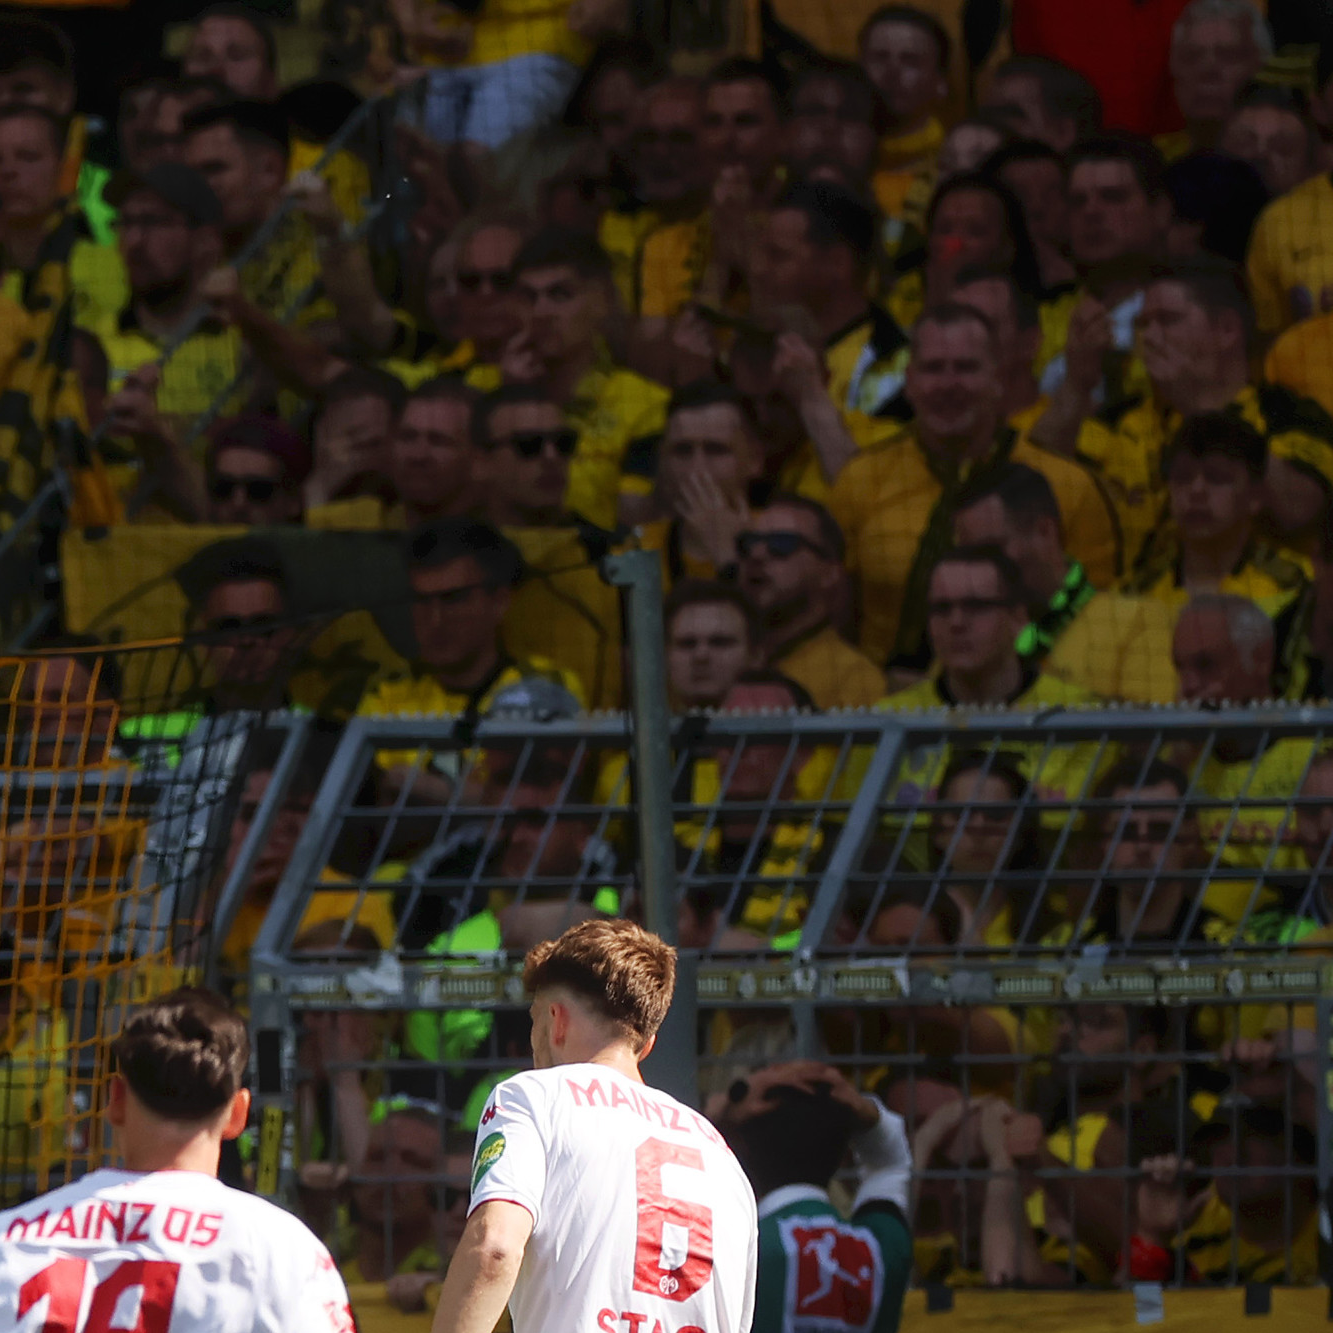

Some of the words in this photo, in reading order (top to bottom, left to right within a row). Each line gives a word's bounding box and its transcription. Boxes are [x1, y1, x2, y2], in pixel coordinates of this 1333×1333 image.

[565, 1078, 690, 1133] MAINZ
[4, 1200, 155, 1244] MAINZ
[161, 1205, 224, 1248] 05
[633, 1136, 714, 1303] 6
